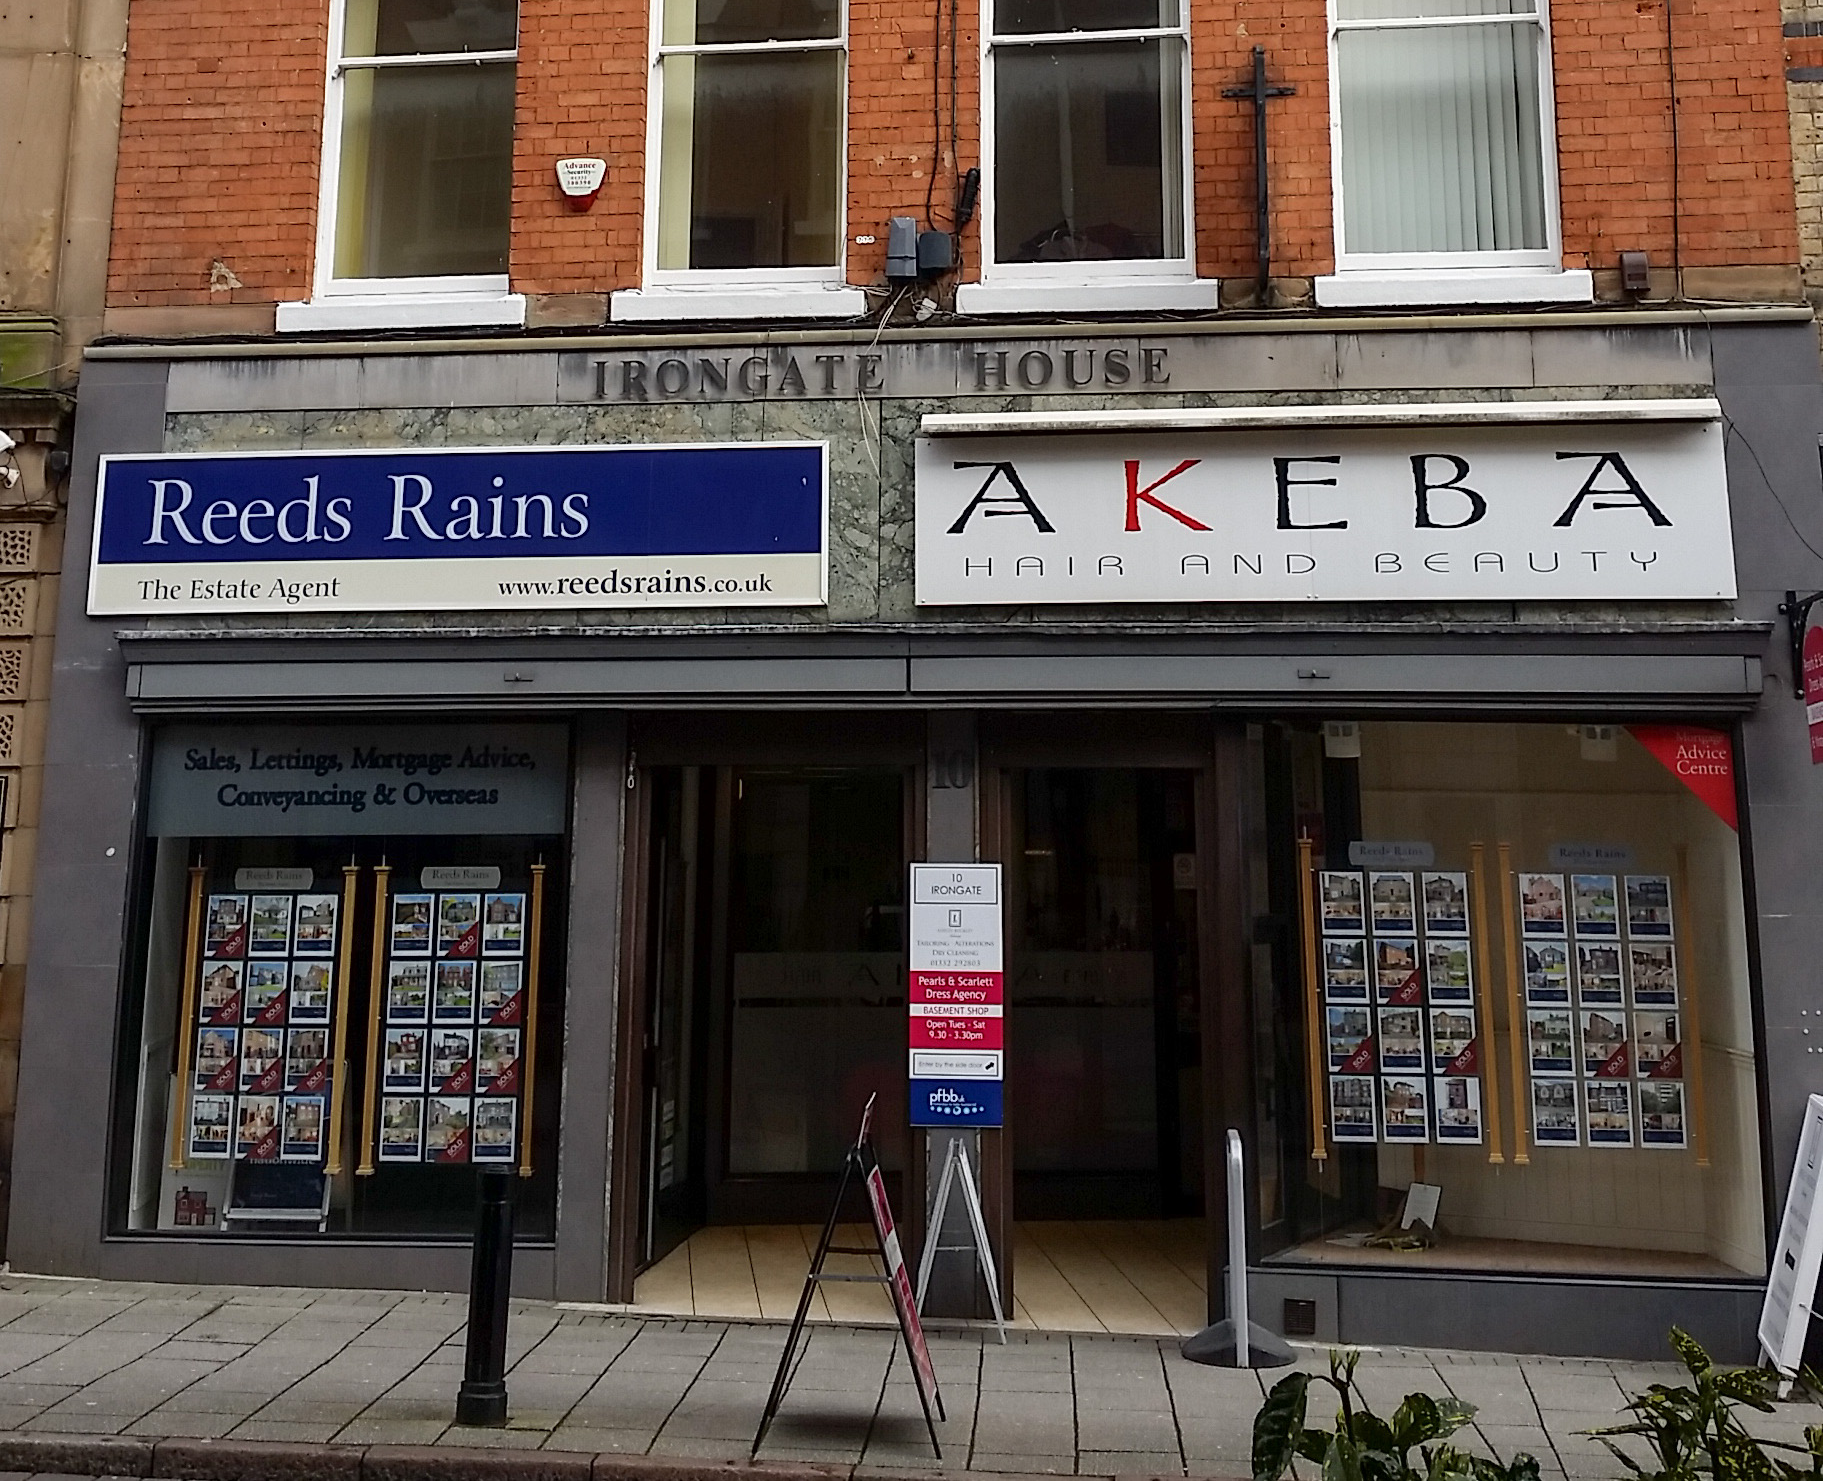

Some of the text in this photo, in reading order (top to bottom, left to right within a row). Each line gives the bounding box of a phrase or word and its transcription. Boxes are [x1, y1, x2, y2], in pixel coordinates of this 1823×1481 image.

[593, 348, 1172, 399] IRONGATE HOUSE
[946, 451, 1674, 534] AKEBA
[143, 474, 590, 546] Reeds Rains
[965, 550, 1659, 578] HAIR AND BEAUTY
[498, 568, 773, 597] www.reedsrains.co.uk
[138, 576, 340, 604] The Estate Agent
[1676, 745, 1726, 759] Advice
[184, 745, 536, 776] Sales, Lettings, Mortgage Advice,
[1677, 761, 1728, 774] Centre
[218, 782, 499, 812] Conveyancing & Overseas
[952, 874, 962, 882] 10
[932, 886, 981, 894] IRONGATE
[918, 976, 994, 987] Pearls & Scarlett
[926, 988, 986, 1001] Dress Agency
[923, 1006, 989, 1015] BASEMENT SHOP
[926, 1020, 947, 1029] Open
[948, 1020, 966, 1029] Tues
[973, 1020, 986, 1029] Sat
[929, 1031, 947, 1039] 9.30
[954, 1031, 983, 1041] 3.30pm
